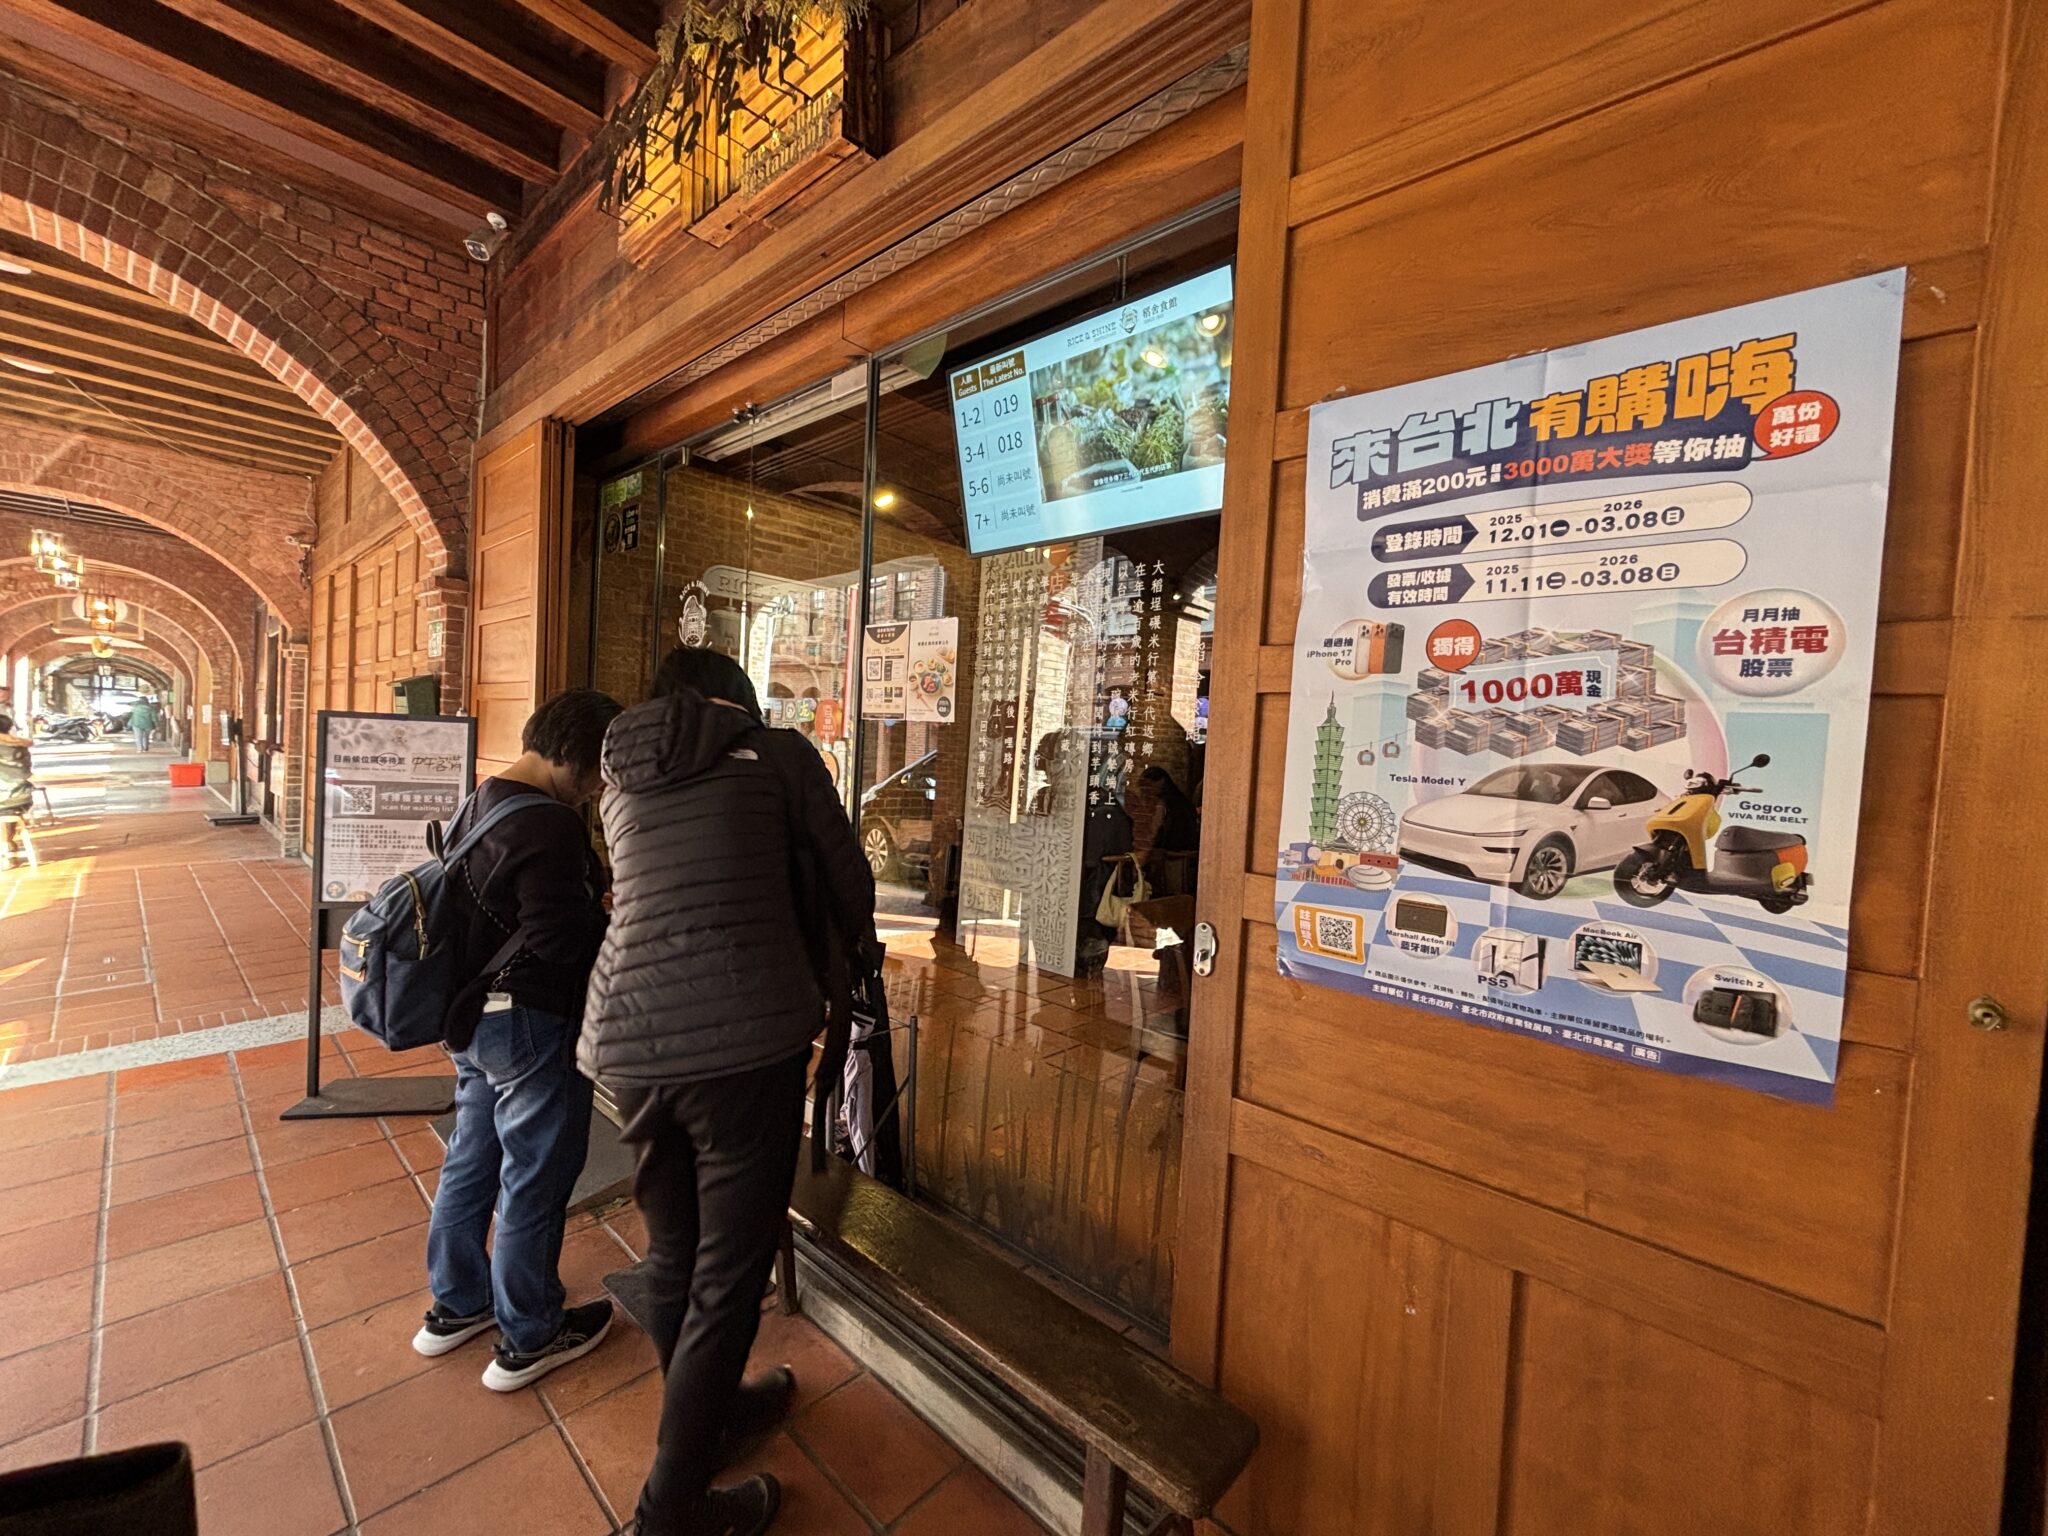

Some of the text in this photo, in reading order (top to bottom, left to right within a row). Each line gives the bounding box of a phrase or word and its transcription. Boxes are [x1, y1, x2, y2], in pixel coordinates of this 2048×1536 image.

[1067, 334, 1084, 347] RICE
[1092, 322, 1116, 338] SHINE
[983, 367, 1025, 388] The Latest No.
[958, 384, 977, 397] Guests
[961, 394, 1019, 428] 1-2 019
[1771, 400, 1822, 427] 萬份
[965, 431, 1023, 463] 3-4 018
[1769, 426, 1822, 448] 好禮
[969, 468, 1033, 497] 5-6 尚未叫號
[974, 504, 1036, 530] 7+ 尚未叫號
[1488, 500, 1644, 527] 2025 2026
[1384, 524, 1463, 554] 登錄時間
[1486, 554, 1640, 577] 2025 2026
[1386, 567, 1452, 589] 發票/收據
[1387, 586, 1449, 606] 有效時間
[1741, 606, 1801, 623] 月月抽
[1323, 637, 1354, 648] 週週抽
[1433, 636, 1476, 658] 獨得
[1712, 625, 1829, 656] 台積電
[1307, 649, 1352, 658] iPhone 17
[1335, 658, 1351, 666] Pro
[1739, 657, 1795, 679] 股票
[1460, 670, 1583, 704] 1000萬
[1389, 774, 1467, 787] Tesla Model Y
[412, 804, 440, 813] waiting
[1739, 800, 1802, 815] Gogoro
[1728, 811, 1808, 825] VIVA MIX BELT
[1386, 930, 1419, 940] Marshall
[1421, 936, 1444, 945] Acton
[1582, 925, 1638, 940] MacBook Air
[1400, 940, 1440, 956] 藍牙喇叭
[1477, 975, 1509, 989] PS5
[1714, 972, 1765, 988] Switch 2
[1634, 1047, 1659, 1061] 廣告
